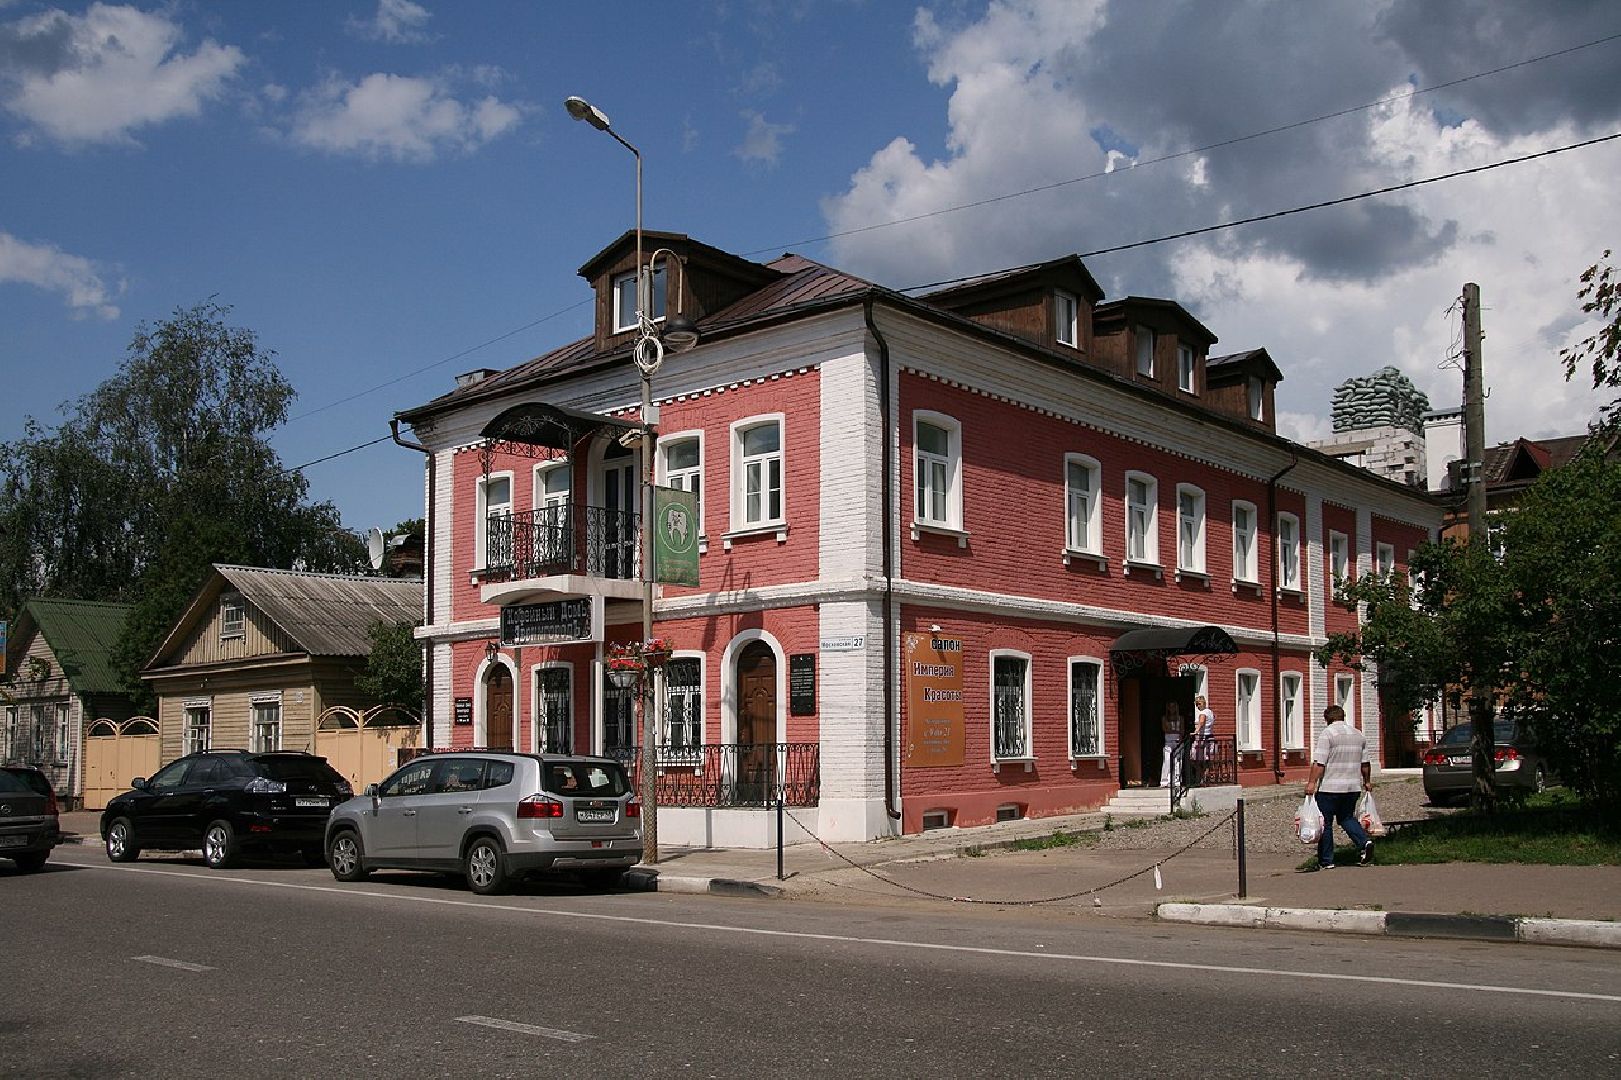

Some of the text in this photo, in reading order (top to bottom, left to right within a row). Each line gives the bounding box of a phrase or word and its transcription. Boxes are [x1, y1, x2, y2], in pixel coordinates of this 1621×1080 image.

[853, 638, 864, 647] 27
[913, 662, 955, 678] Империя
[923, 687, 962, 702] Красоты
